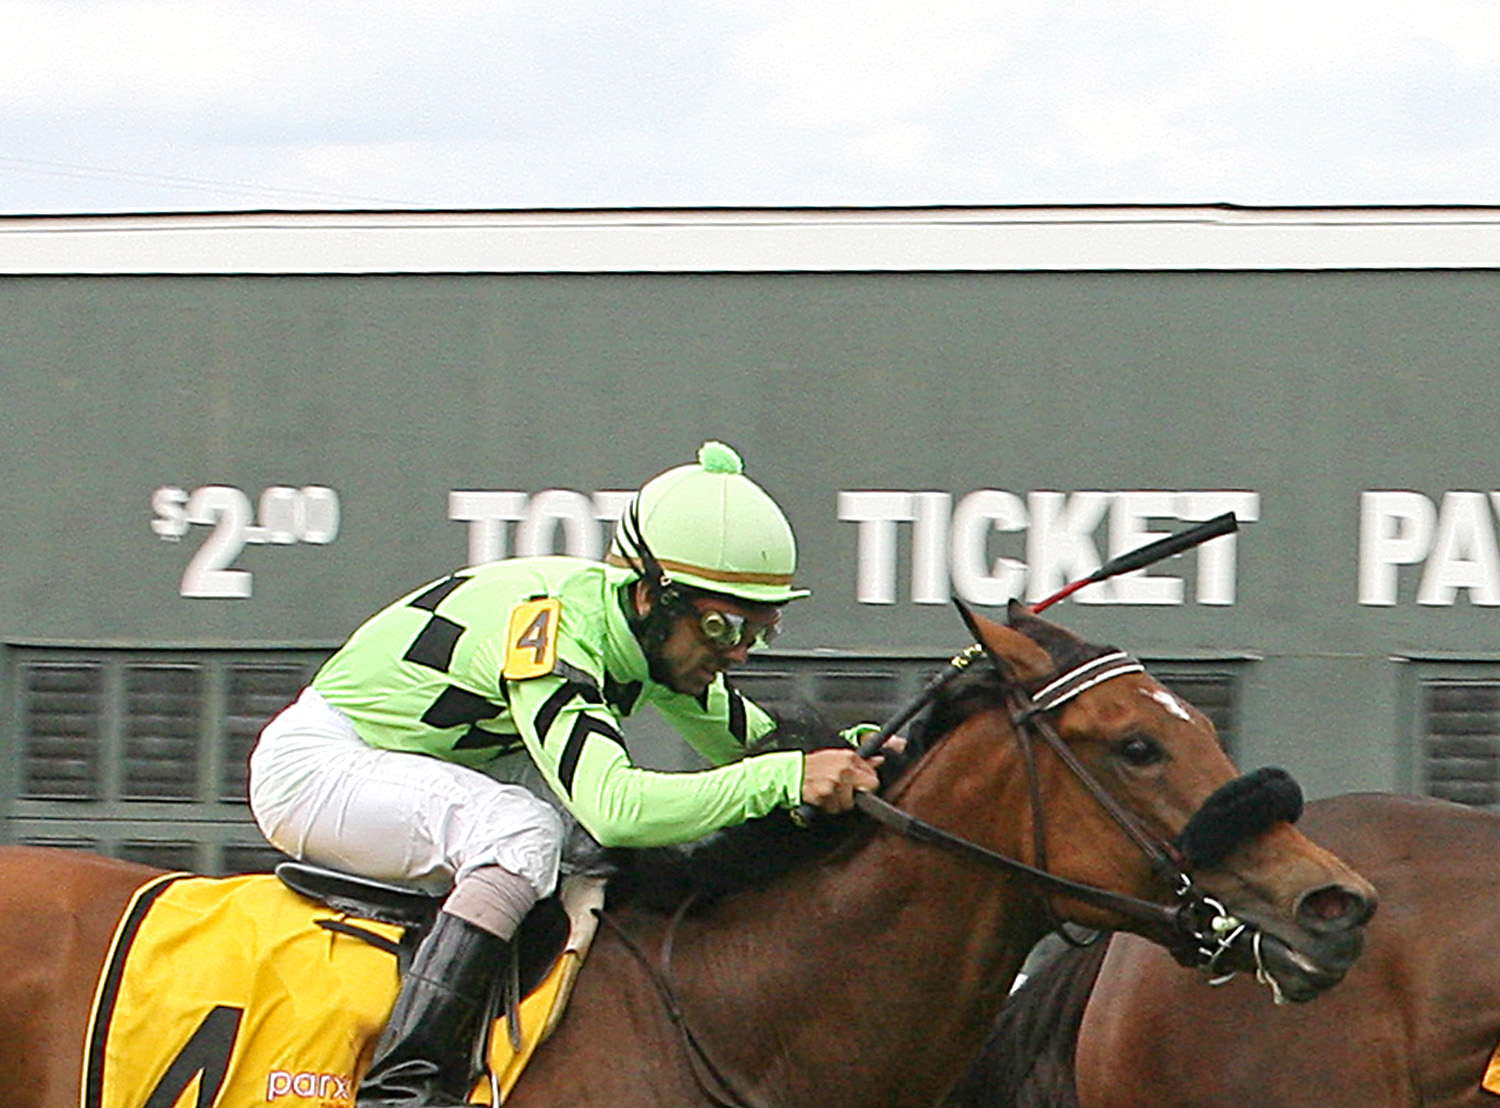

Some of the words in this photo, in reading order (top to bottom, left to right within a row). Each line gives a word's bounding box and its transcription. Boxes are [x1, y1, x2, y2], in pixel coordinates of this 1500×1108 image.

[836, 489, 1260, 605] TICKET
[516, 608, 551, 665] 4
[266, 1069, 350, 1102] parx
